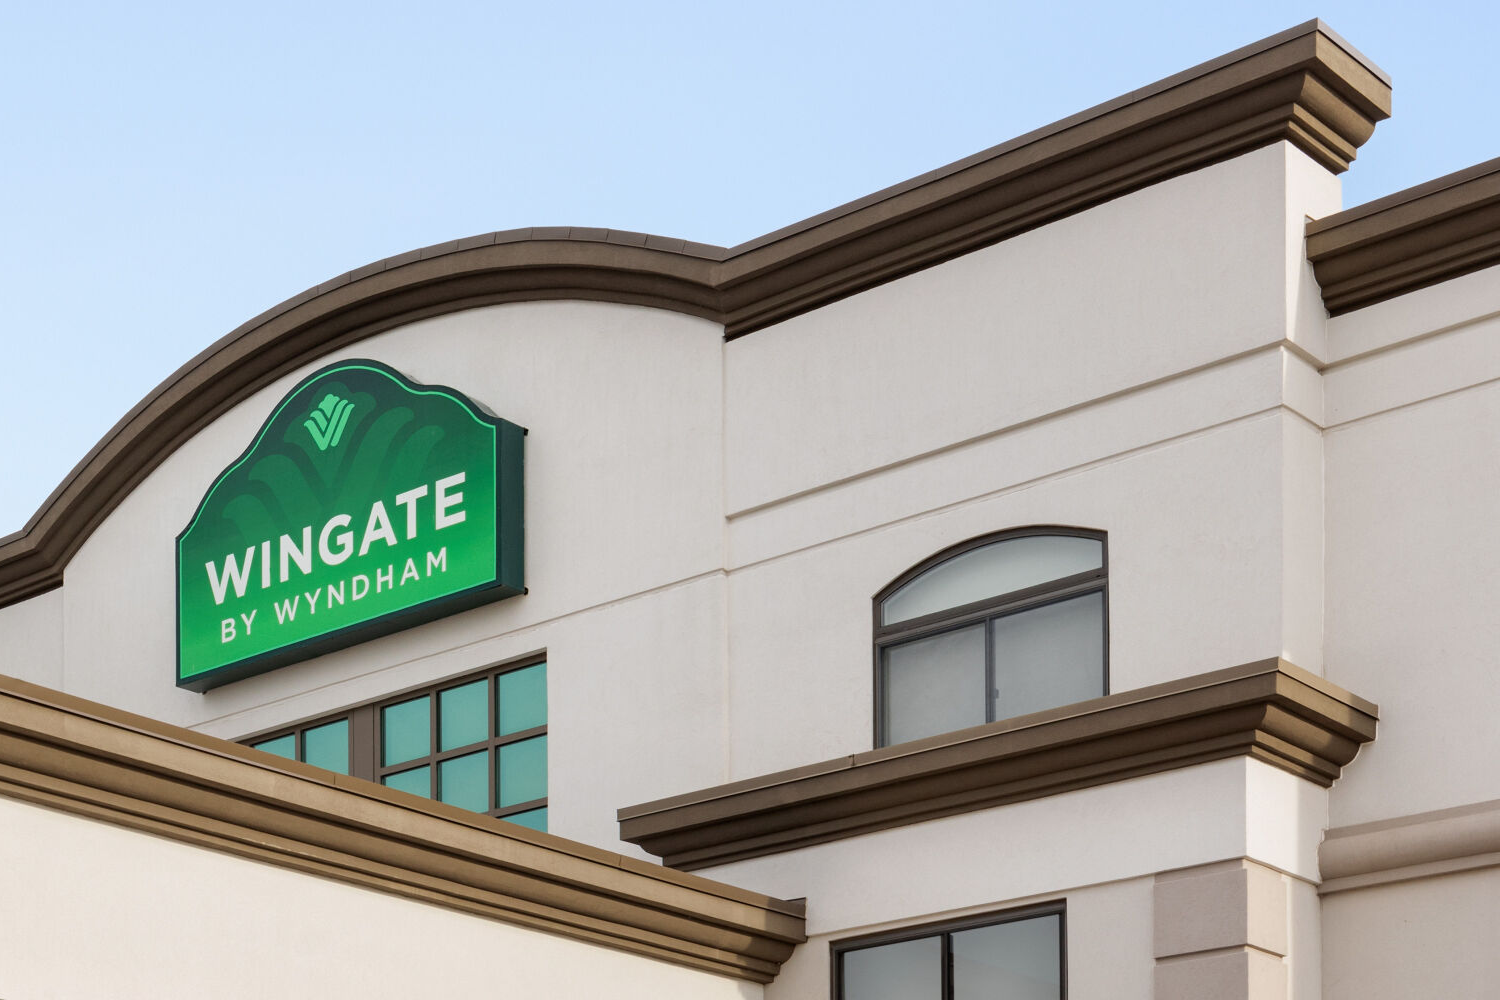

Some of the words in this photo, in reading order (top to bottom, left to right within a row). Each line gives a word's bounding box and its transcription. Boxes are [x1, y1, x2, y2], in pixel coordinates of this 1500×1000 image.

[205, 471, 466, 605] WINGATE
[221, 609, 258, 643] BY
[274, 546, 447, 625] WYNDHAM
